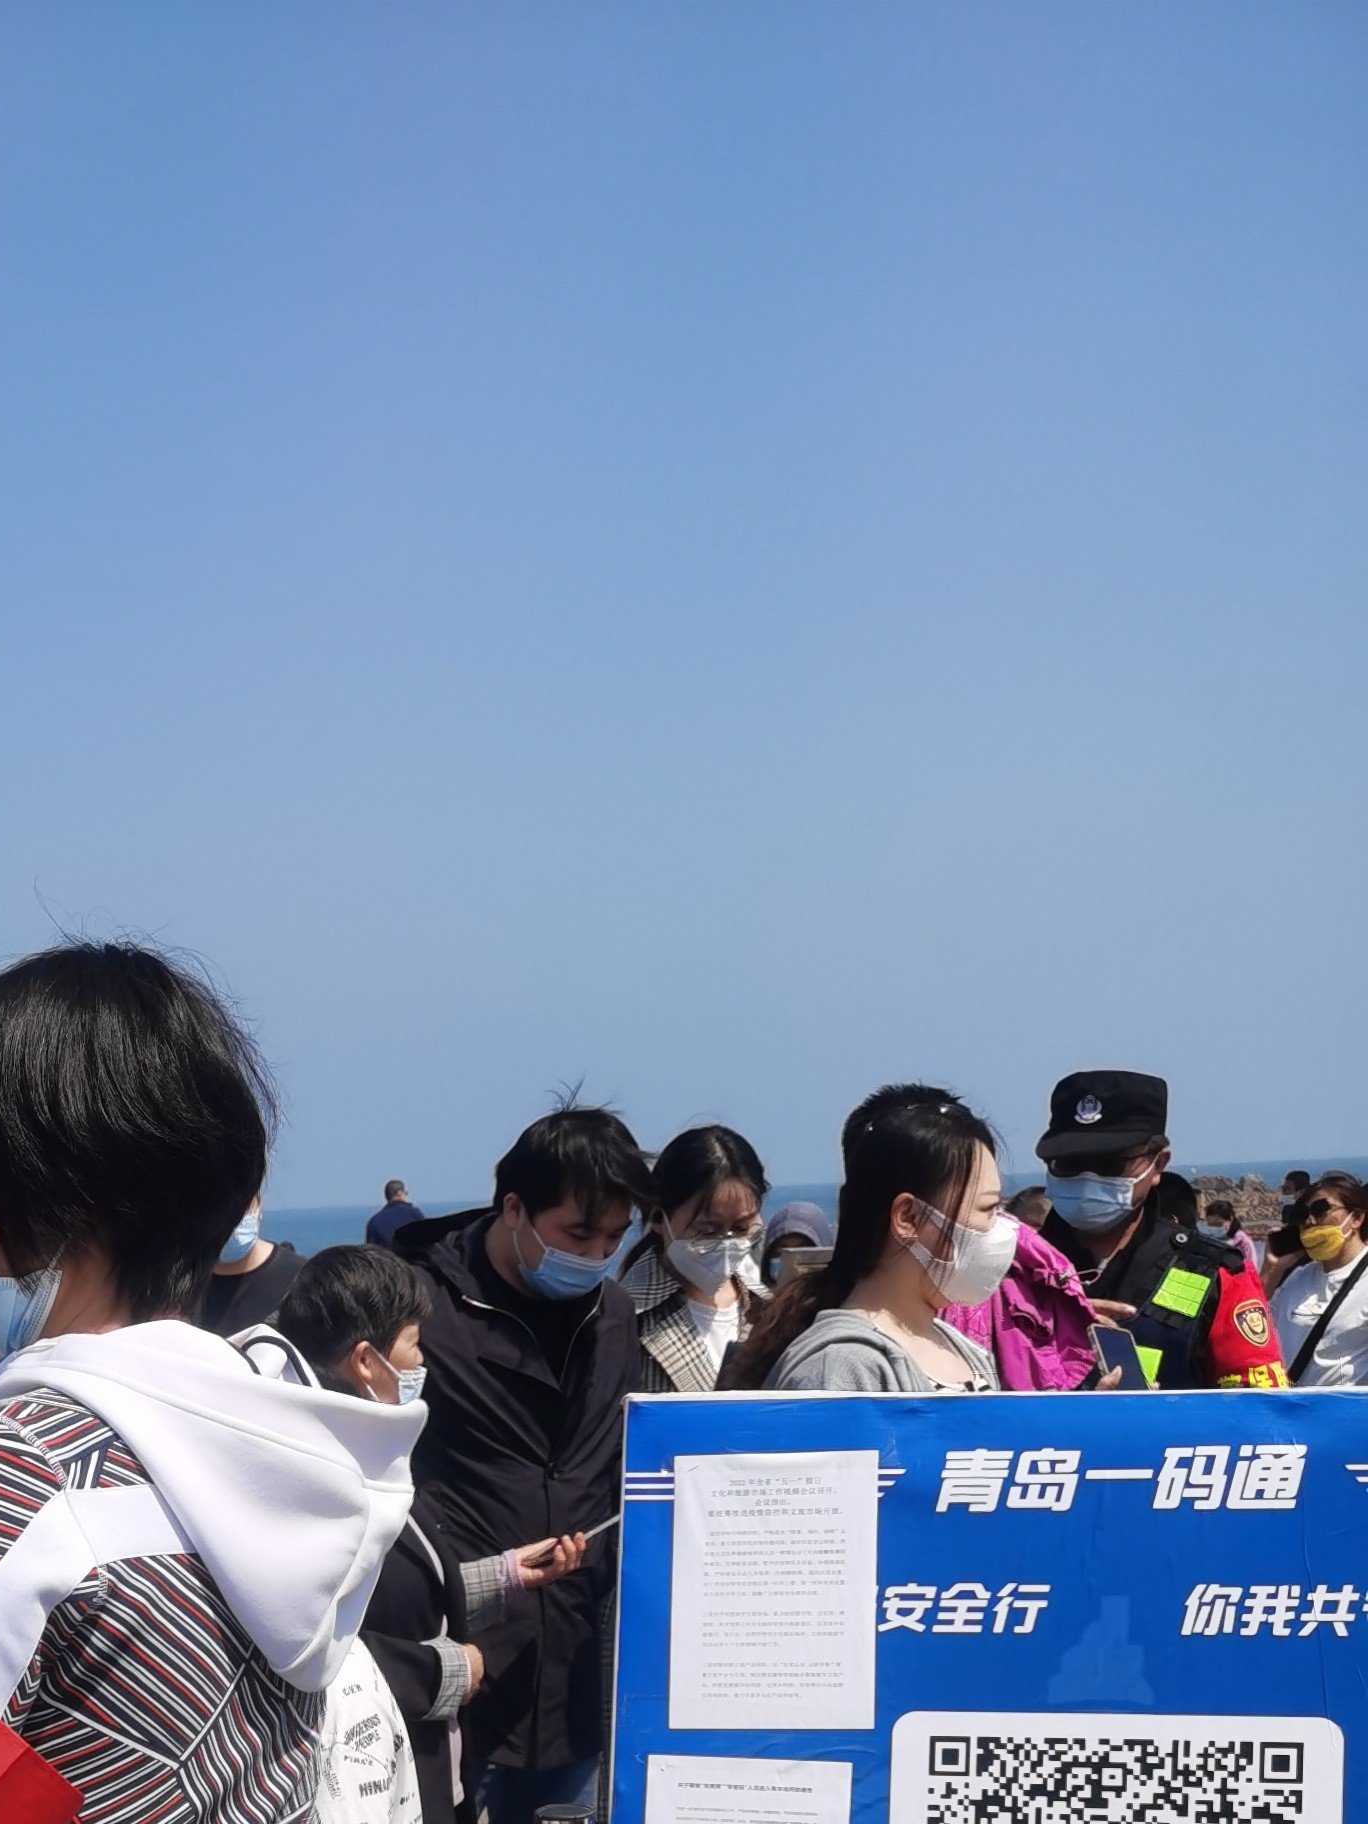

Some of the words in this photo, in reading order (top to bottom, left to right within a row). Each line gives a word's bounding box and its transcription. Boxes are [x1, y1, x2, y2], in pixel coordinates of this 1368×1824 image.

[935, 1444, 1308, 1513] 青岛一码通
[876, 1582, 1052, 1634] 安全行
[1180, 1583, 1368, 1638] 你我共
